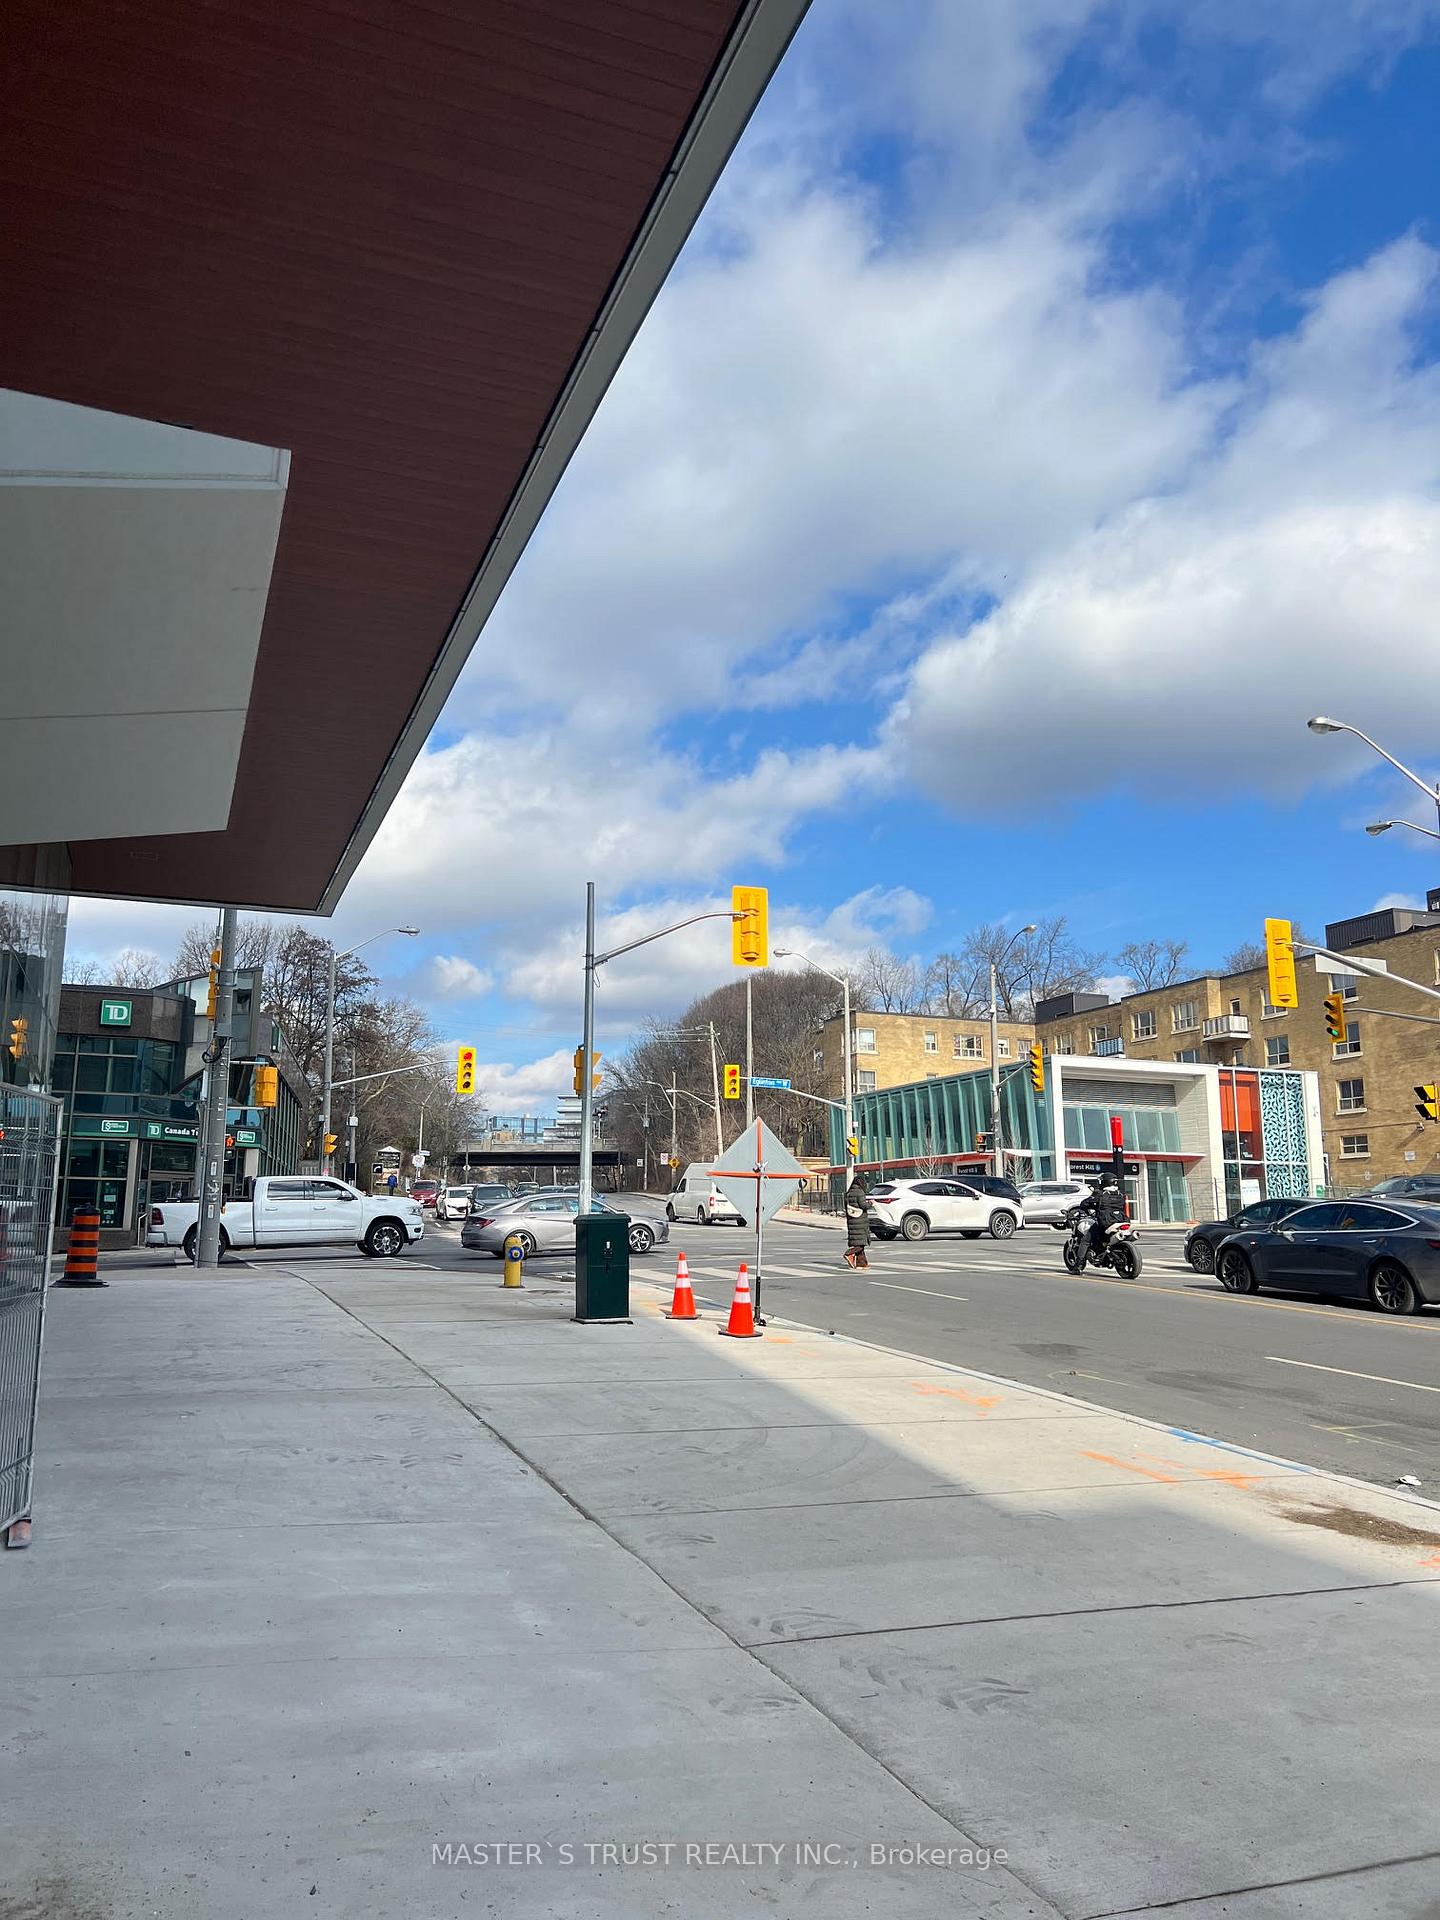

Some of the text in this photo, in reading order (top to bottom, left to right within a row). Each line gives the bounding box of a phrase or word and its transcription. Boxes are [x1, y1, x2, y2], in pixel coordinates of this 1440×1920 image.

[105, 1005, 128, 1020] TD
[149, 1125, 160, 1135] TD
[164, 1126, 190, 1136] Canada
